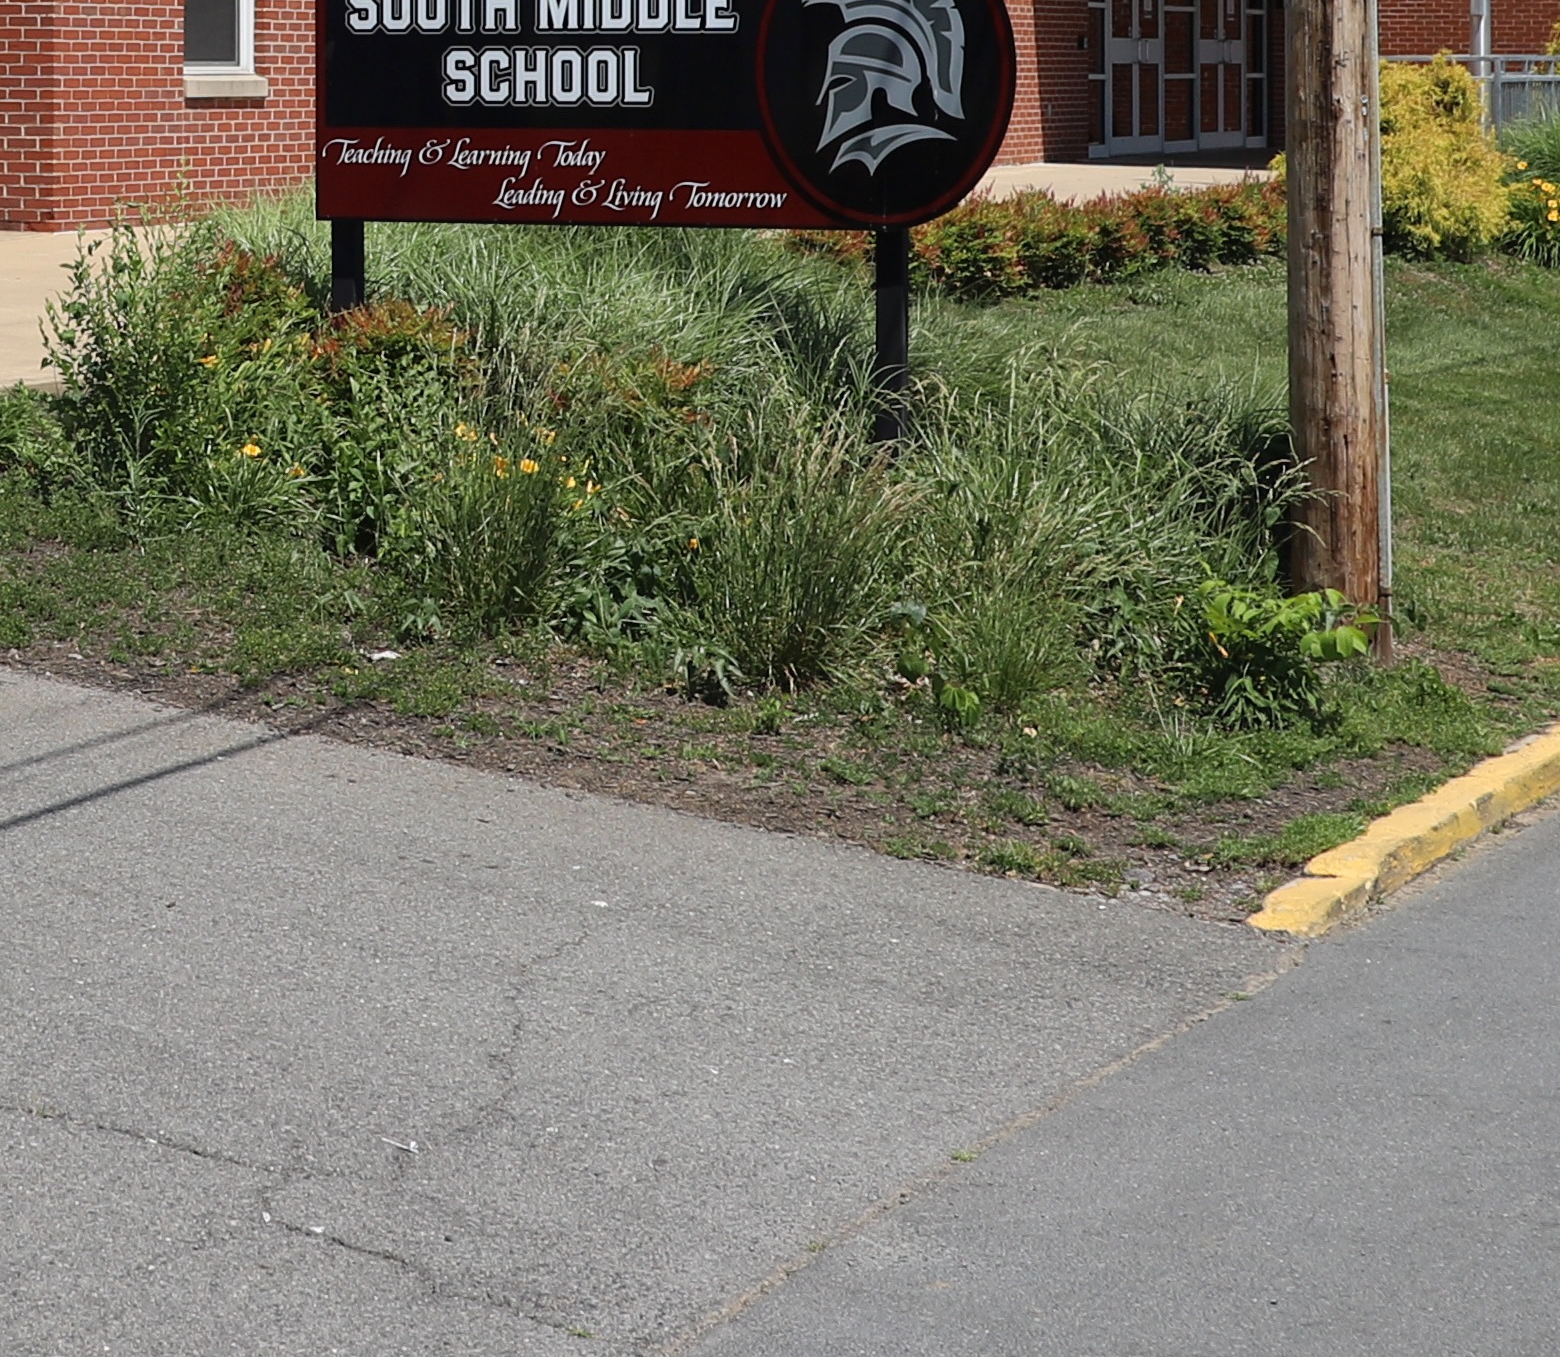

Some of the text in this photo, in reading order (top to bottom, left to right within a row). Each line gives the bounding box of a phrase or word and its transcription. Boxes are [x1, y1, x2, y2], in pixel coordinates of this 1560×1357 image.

[441, 46, 655, 107] SCHOOL
[322, 136, 606, 179] Teaching & Learning Today
[492, 176, 787, 220] Leading & Living Tomorrow
